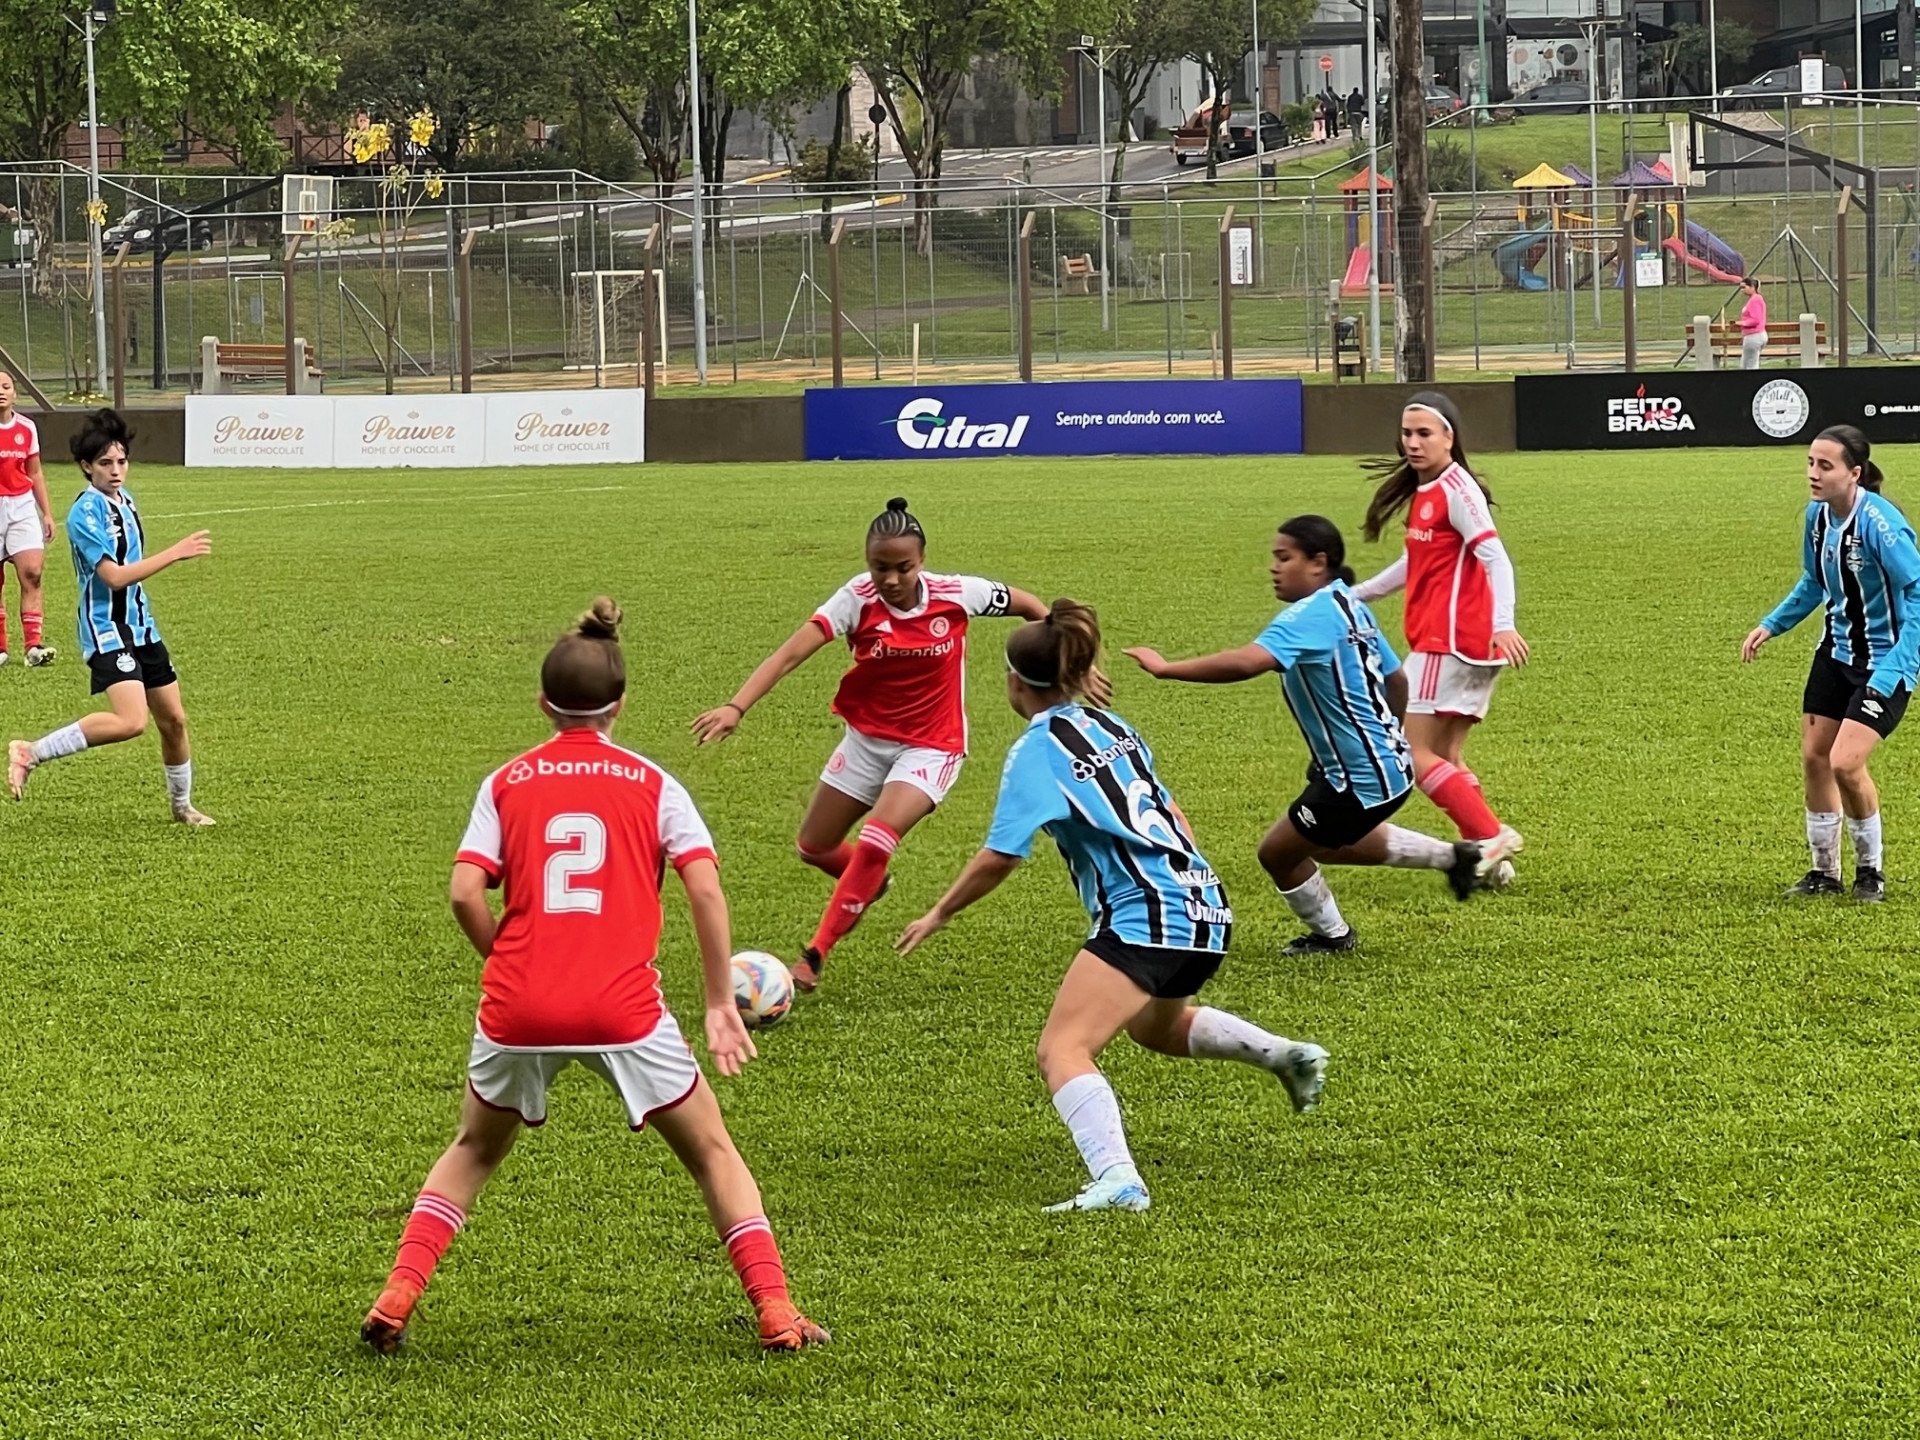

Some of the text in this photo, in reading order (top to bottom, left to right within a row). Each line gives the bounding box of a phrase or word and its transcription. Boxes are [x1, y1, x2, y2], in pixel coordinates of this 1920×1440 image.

[1055, 409, 1226, 429] Sempre andando com você.
[1607, 396, 1682, 415] FEITO
[213, 415, 305, 444] Prawer
[362, 415, 456, 443] Prawer
[514, 412, 610, 441] Prawer
[896, 397, 1030, 449] Citral
[1608, 413, 1696, 432] BRASA
[213, 446, 304, 455] HOME OF CHOCOLATE
[361, 445, 455, 455] HOME OF CHOCOLATE
[513, 442, 610, 453] HOME OF CHOCOLATE
[1459, 488, 1479, 517] vero
[1863, 501, 1890, 532] vero
[886, 635, 955, 658] banrisul
[538, 757, 646, 784] banrisul
[1127, 779, 1185, 851] 6
[544, 813, 607, 915] 2
